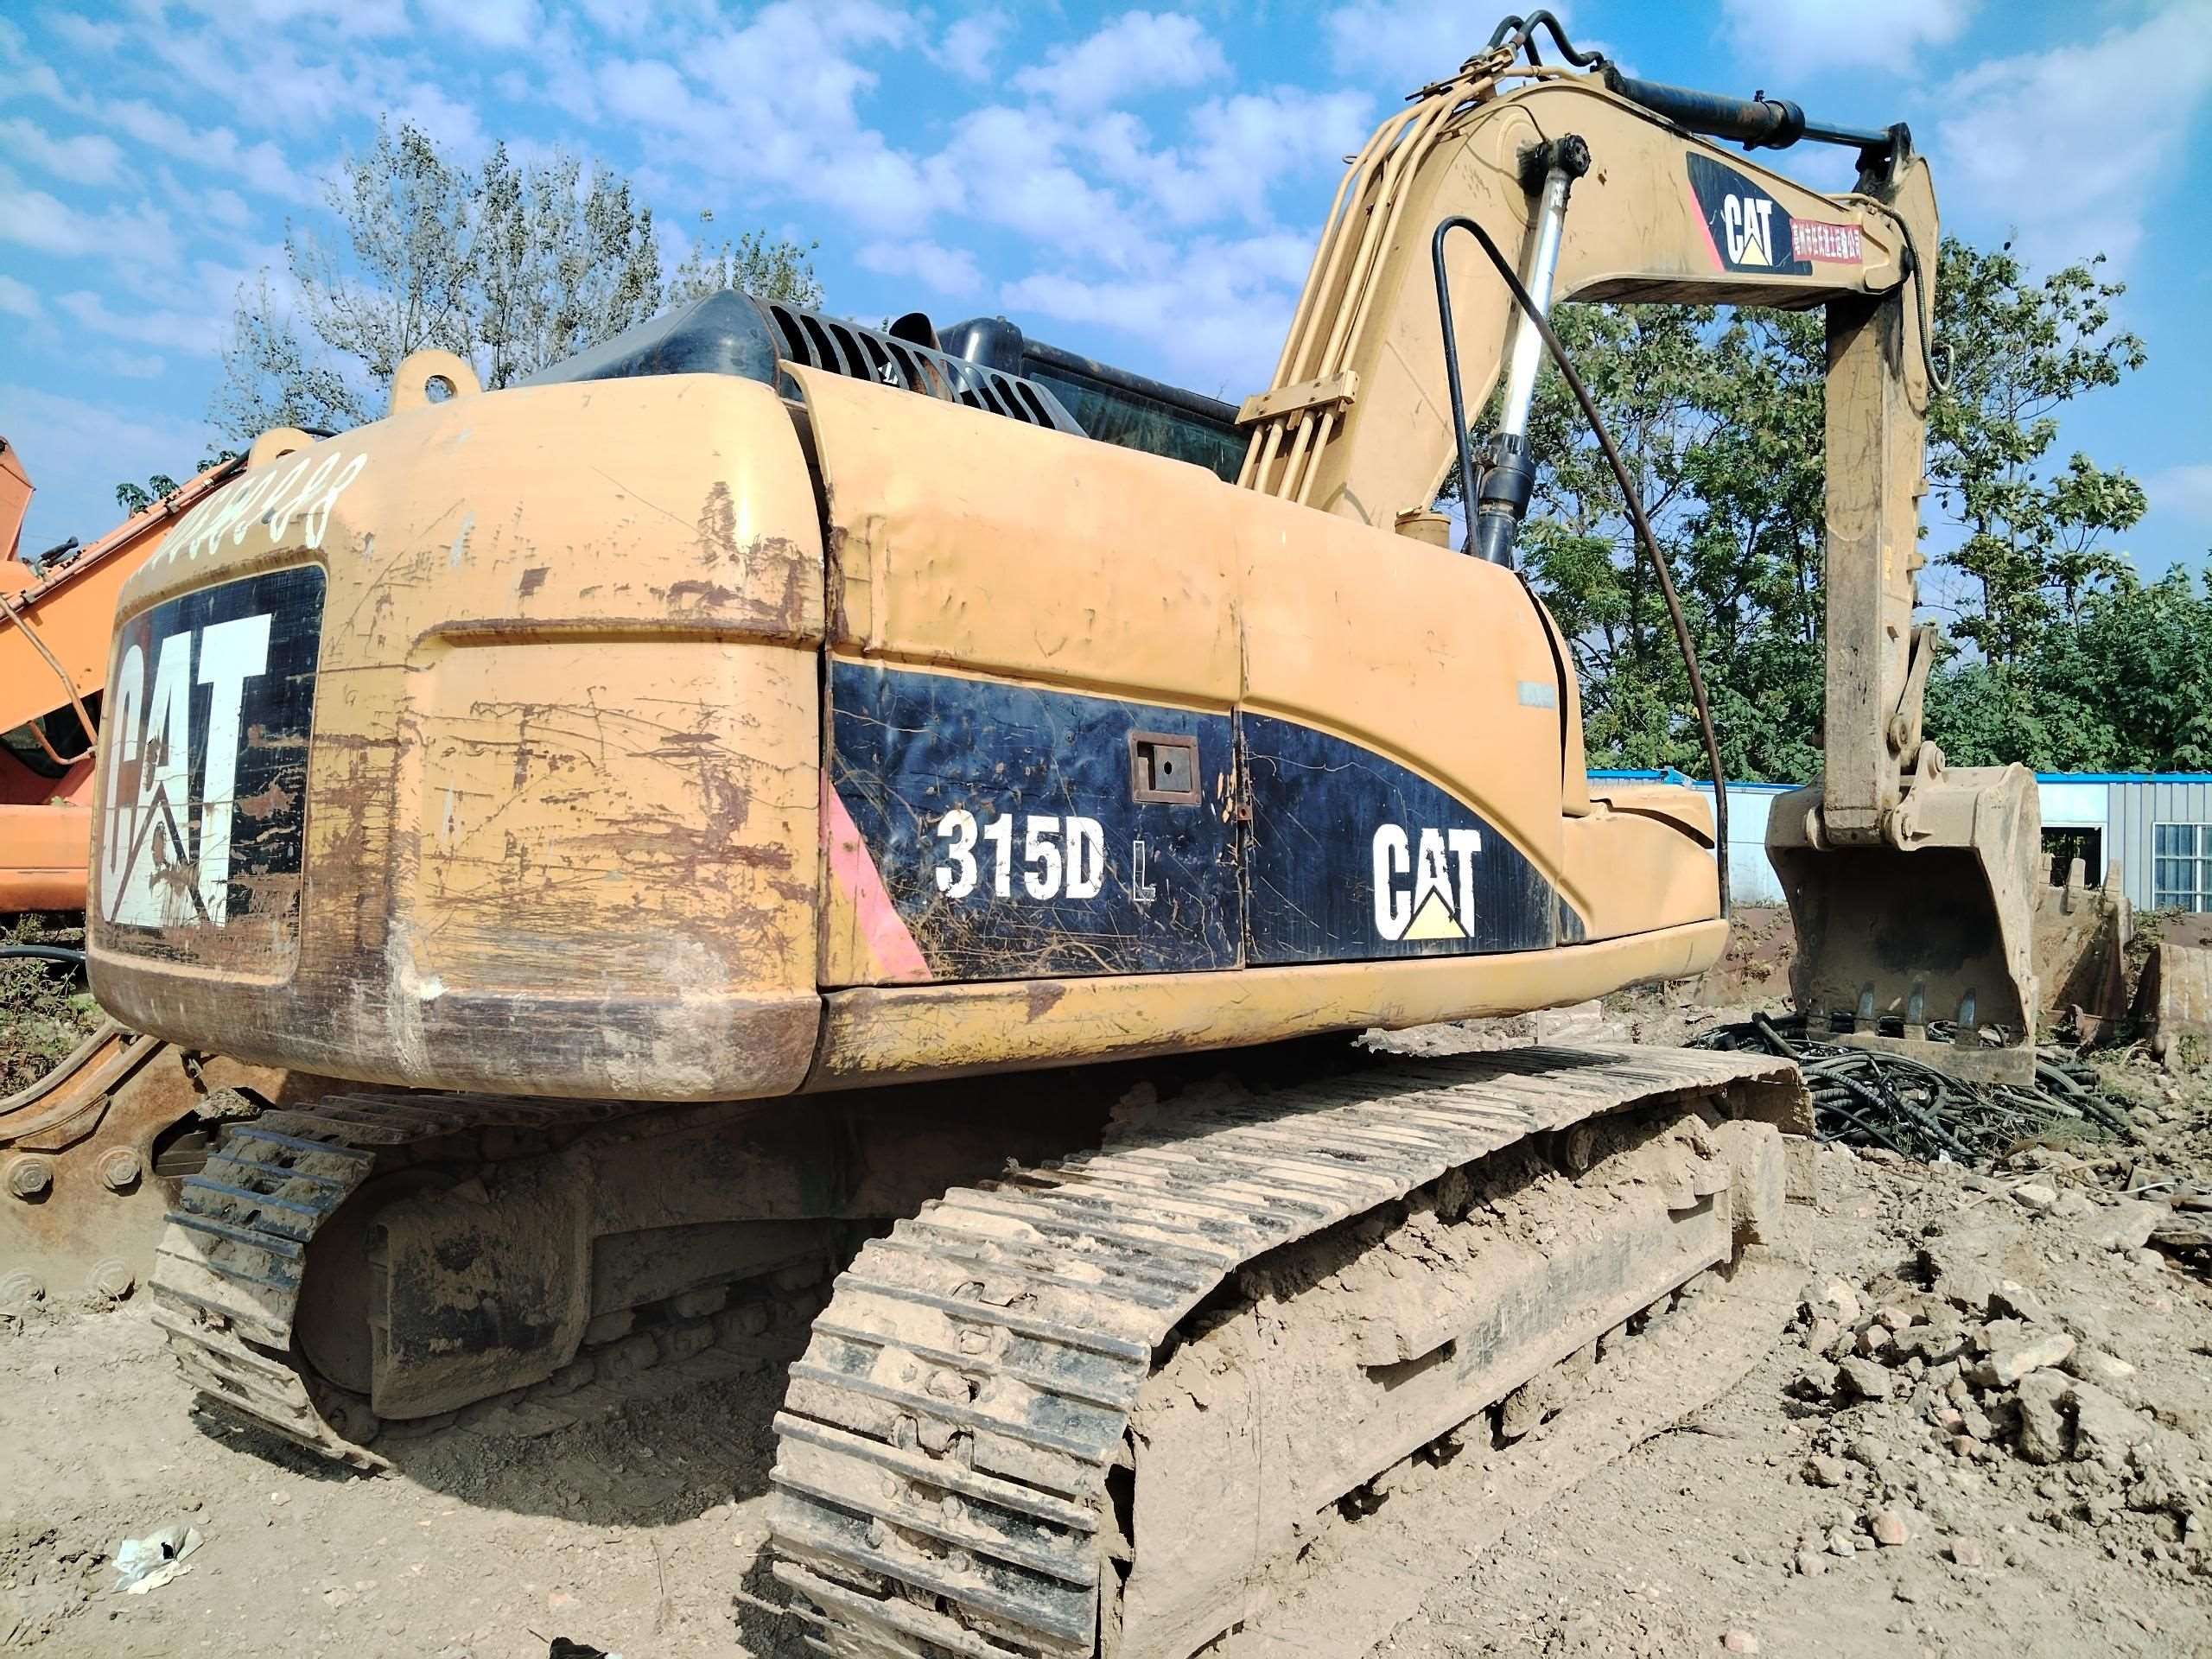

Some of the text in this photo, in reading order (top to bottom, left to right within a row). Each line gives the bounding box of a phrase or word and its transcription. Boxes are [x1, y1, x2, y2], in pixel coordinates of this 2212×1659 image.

[1724, 194, 1773, 266] CAT
[102, 613, 272, 928] CAT
[936, 809, 1156, 901] 315D L
[1373, 823, 1481, 940] CAT
